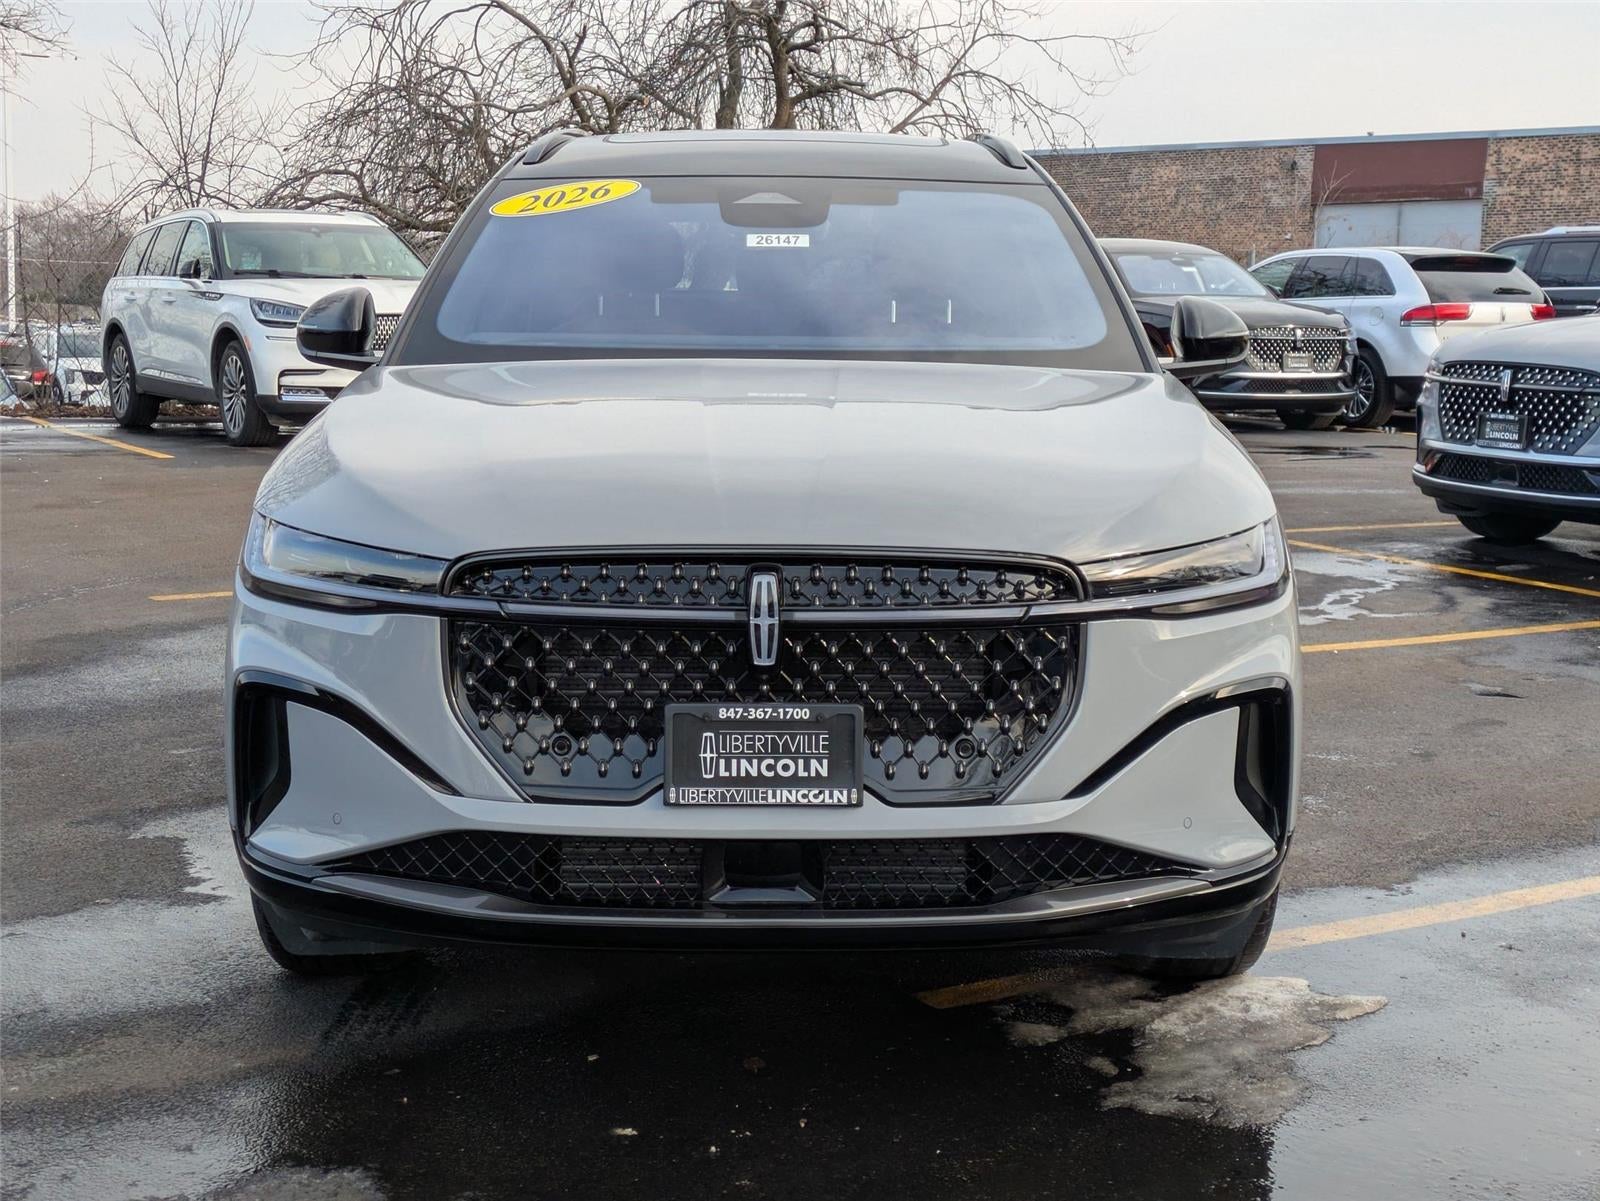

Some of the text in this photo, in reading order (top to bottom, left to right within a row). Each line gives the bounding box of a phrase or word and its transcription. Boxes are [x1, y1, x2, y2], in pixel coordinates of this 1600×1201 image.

[516, 183, 612, 214] 2026
[755, 235, 800, 246] 26147
[1489, 431, 1519, 441] LINCOLN
[718, 707, 810, 720] 847-367-1700
[719, 734, 829, 753] LIBERTYVILLE
[719, 758, 829, 777] LINCOLN
